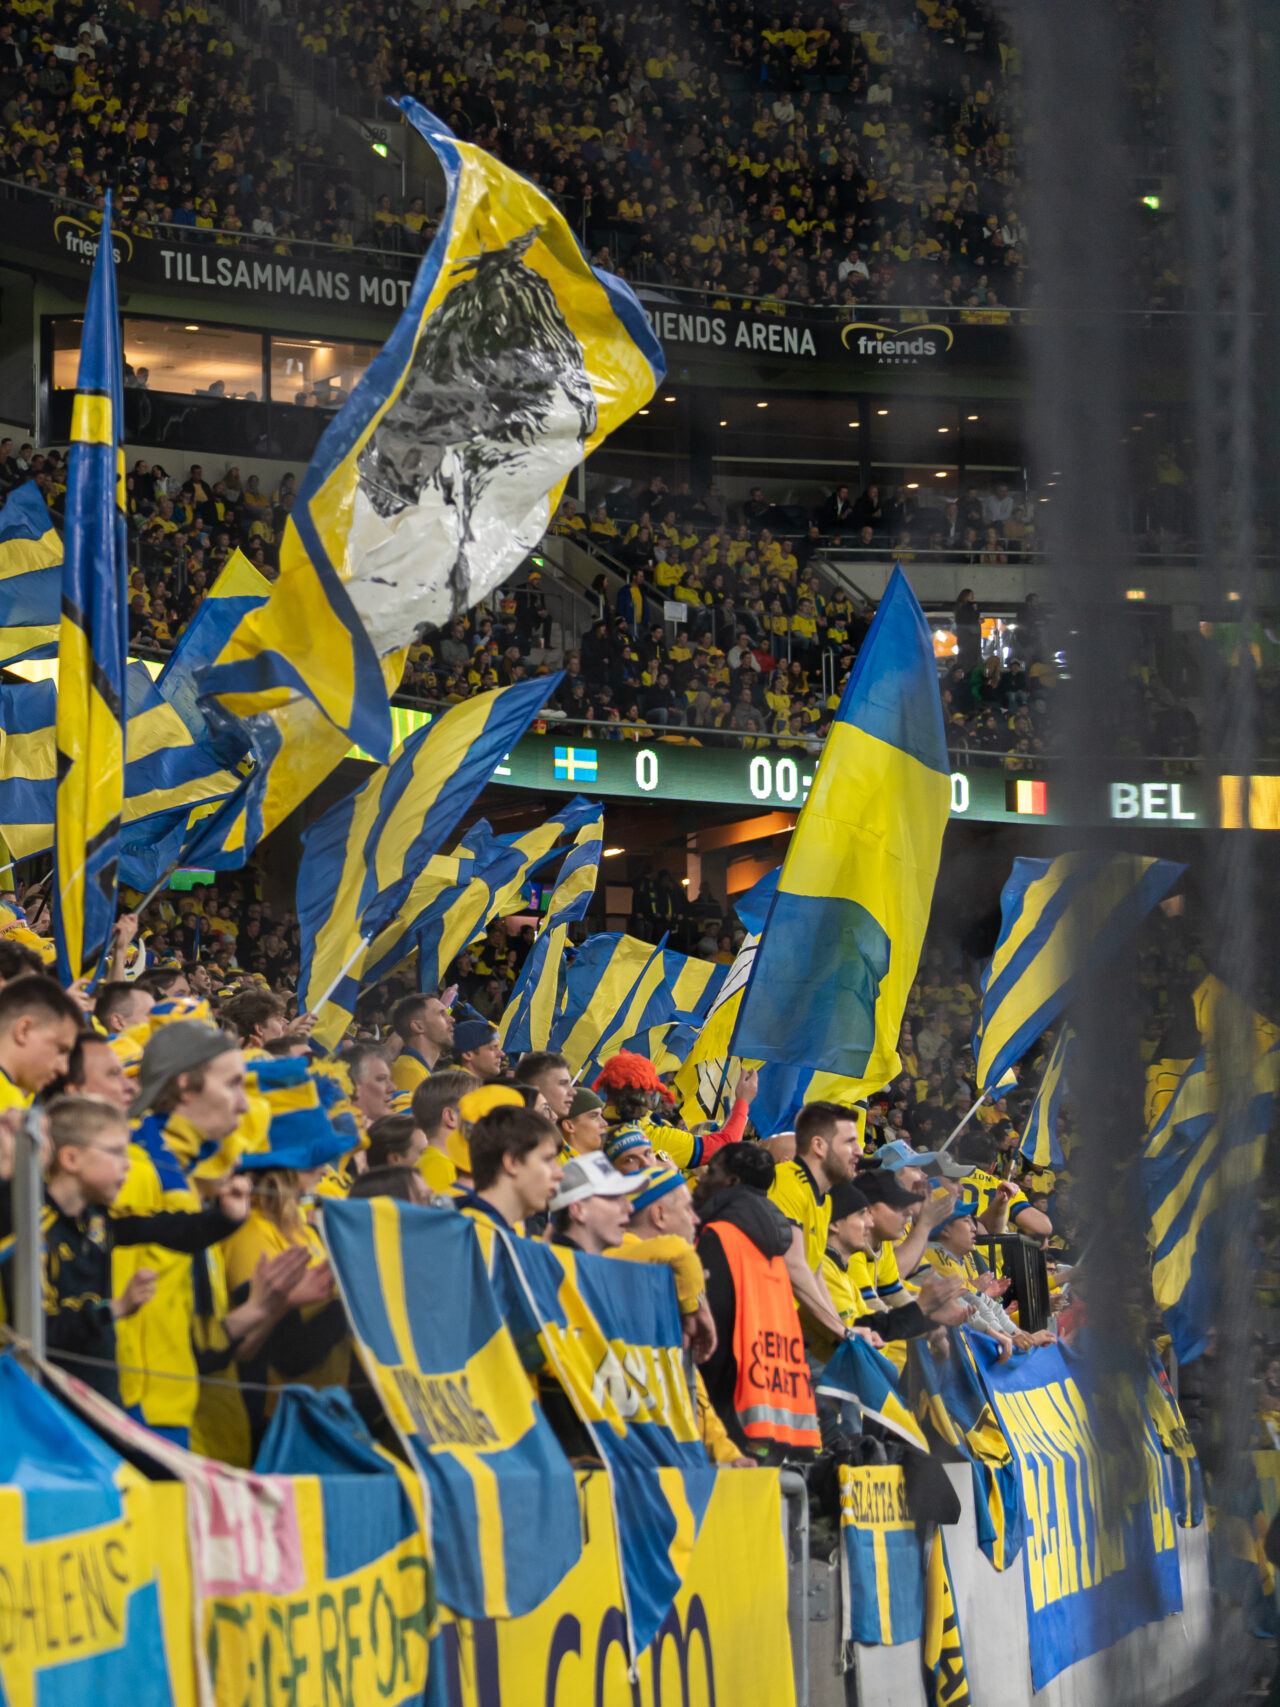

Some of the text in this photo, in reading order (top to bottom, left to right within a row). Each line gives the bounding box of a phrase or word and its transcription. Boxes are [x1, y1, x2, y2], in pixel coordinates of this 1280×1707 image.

[66, 231, 121, 264] friens
[160, 250, 412, 309] TILLSAMMANS MOT
[734, 321, 817, 356] ARENA
[857, 333, 936, 356] friends
[877, 357, 919, 365] ARENA
[635, 749, 659, 791] 0
[1110, 781, 1196, 820] BEL
